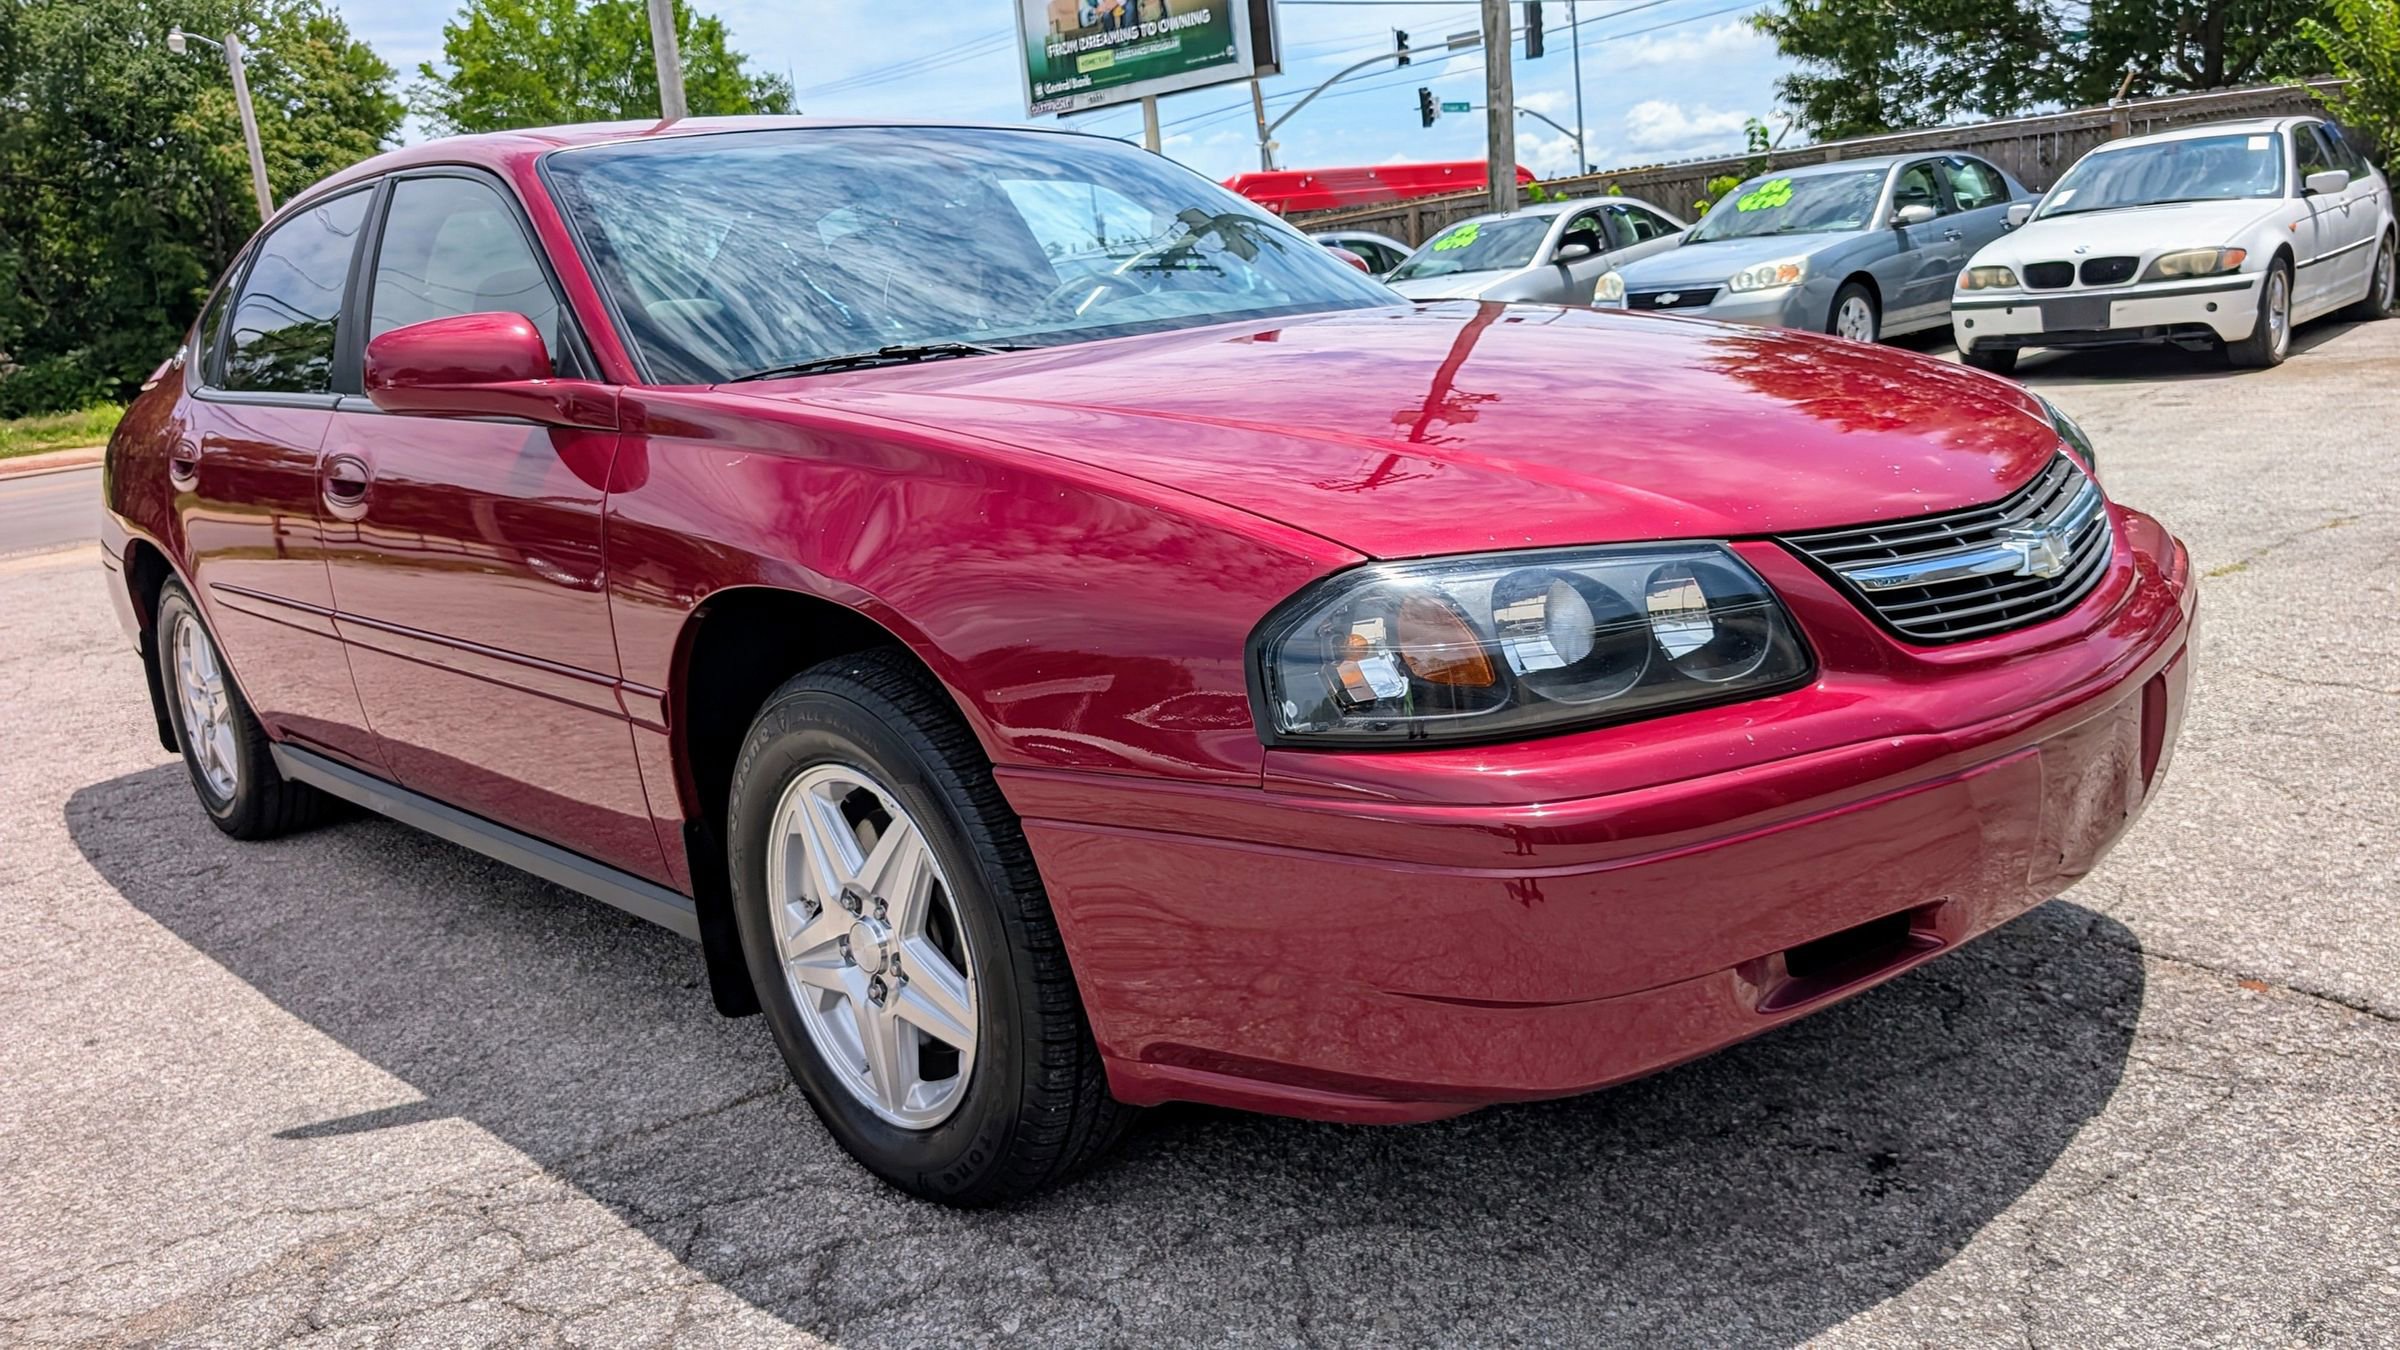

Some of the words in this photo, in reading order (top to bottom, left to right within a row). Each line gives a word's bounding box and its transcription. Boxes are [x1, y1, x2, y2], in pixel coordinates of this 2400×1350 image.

[1047, 40, 1078, 58] FROM
[1079, 26, 1139, 50] DREAMING
[1140, 22, 1157, 36] TO
[1158, 9, 1211, 33] OWNING
[1044, 78, 1072, 94] Central
[1072, 74, 1092, 89] Bank
